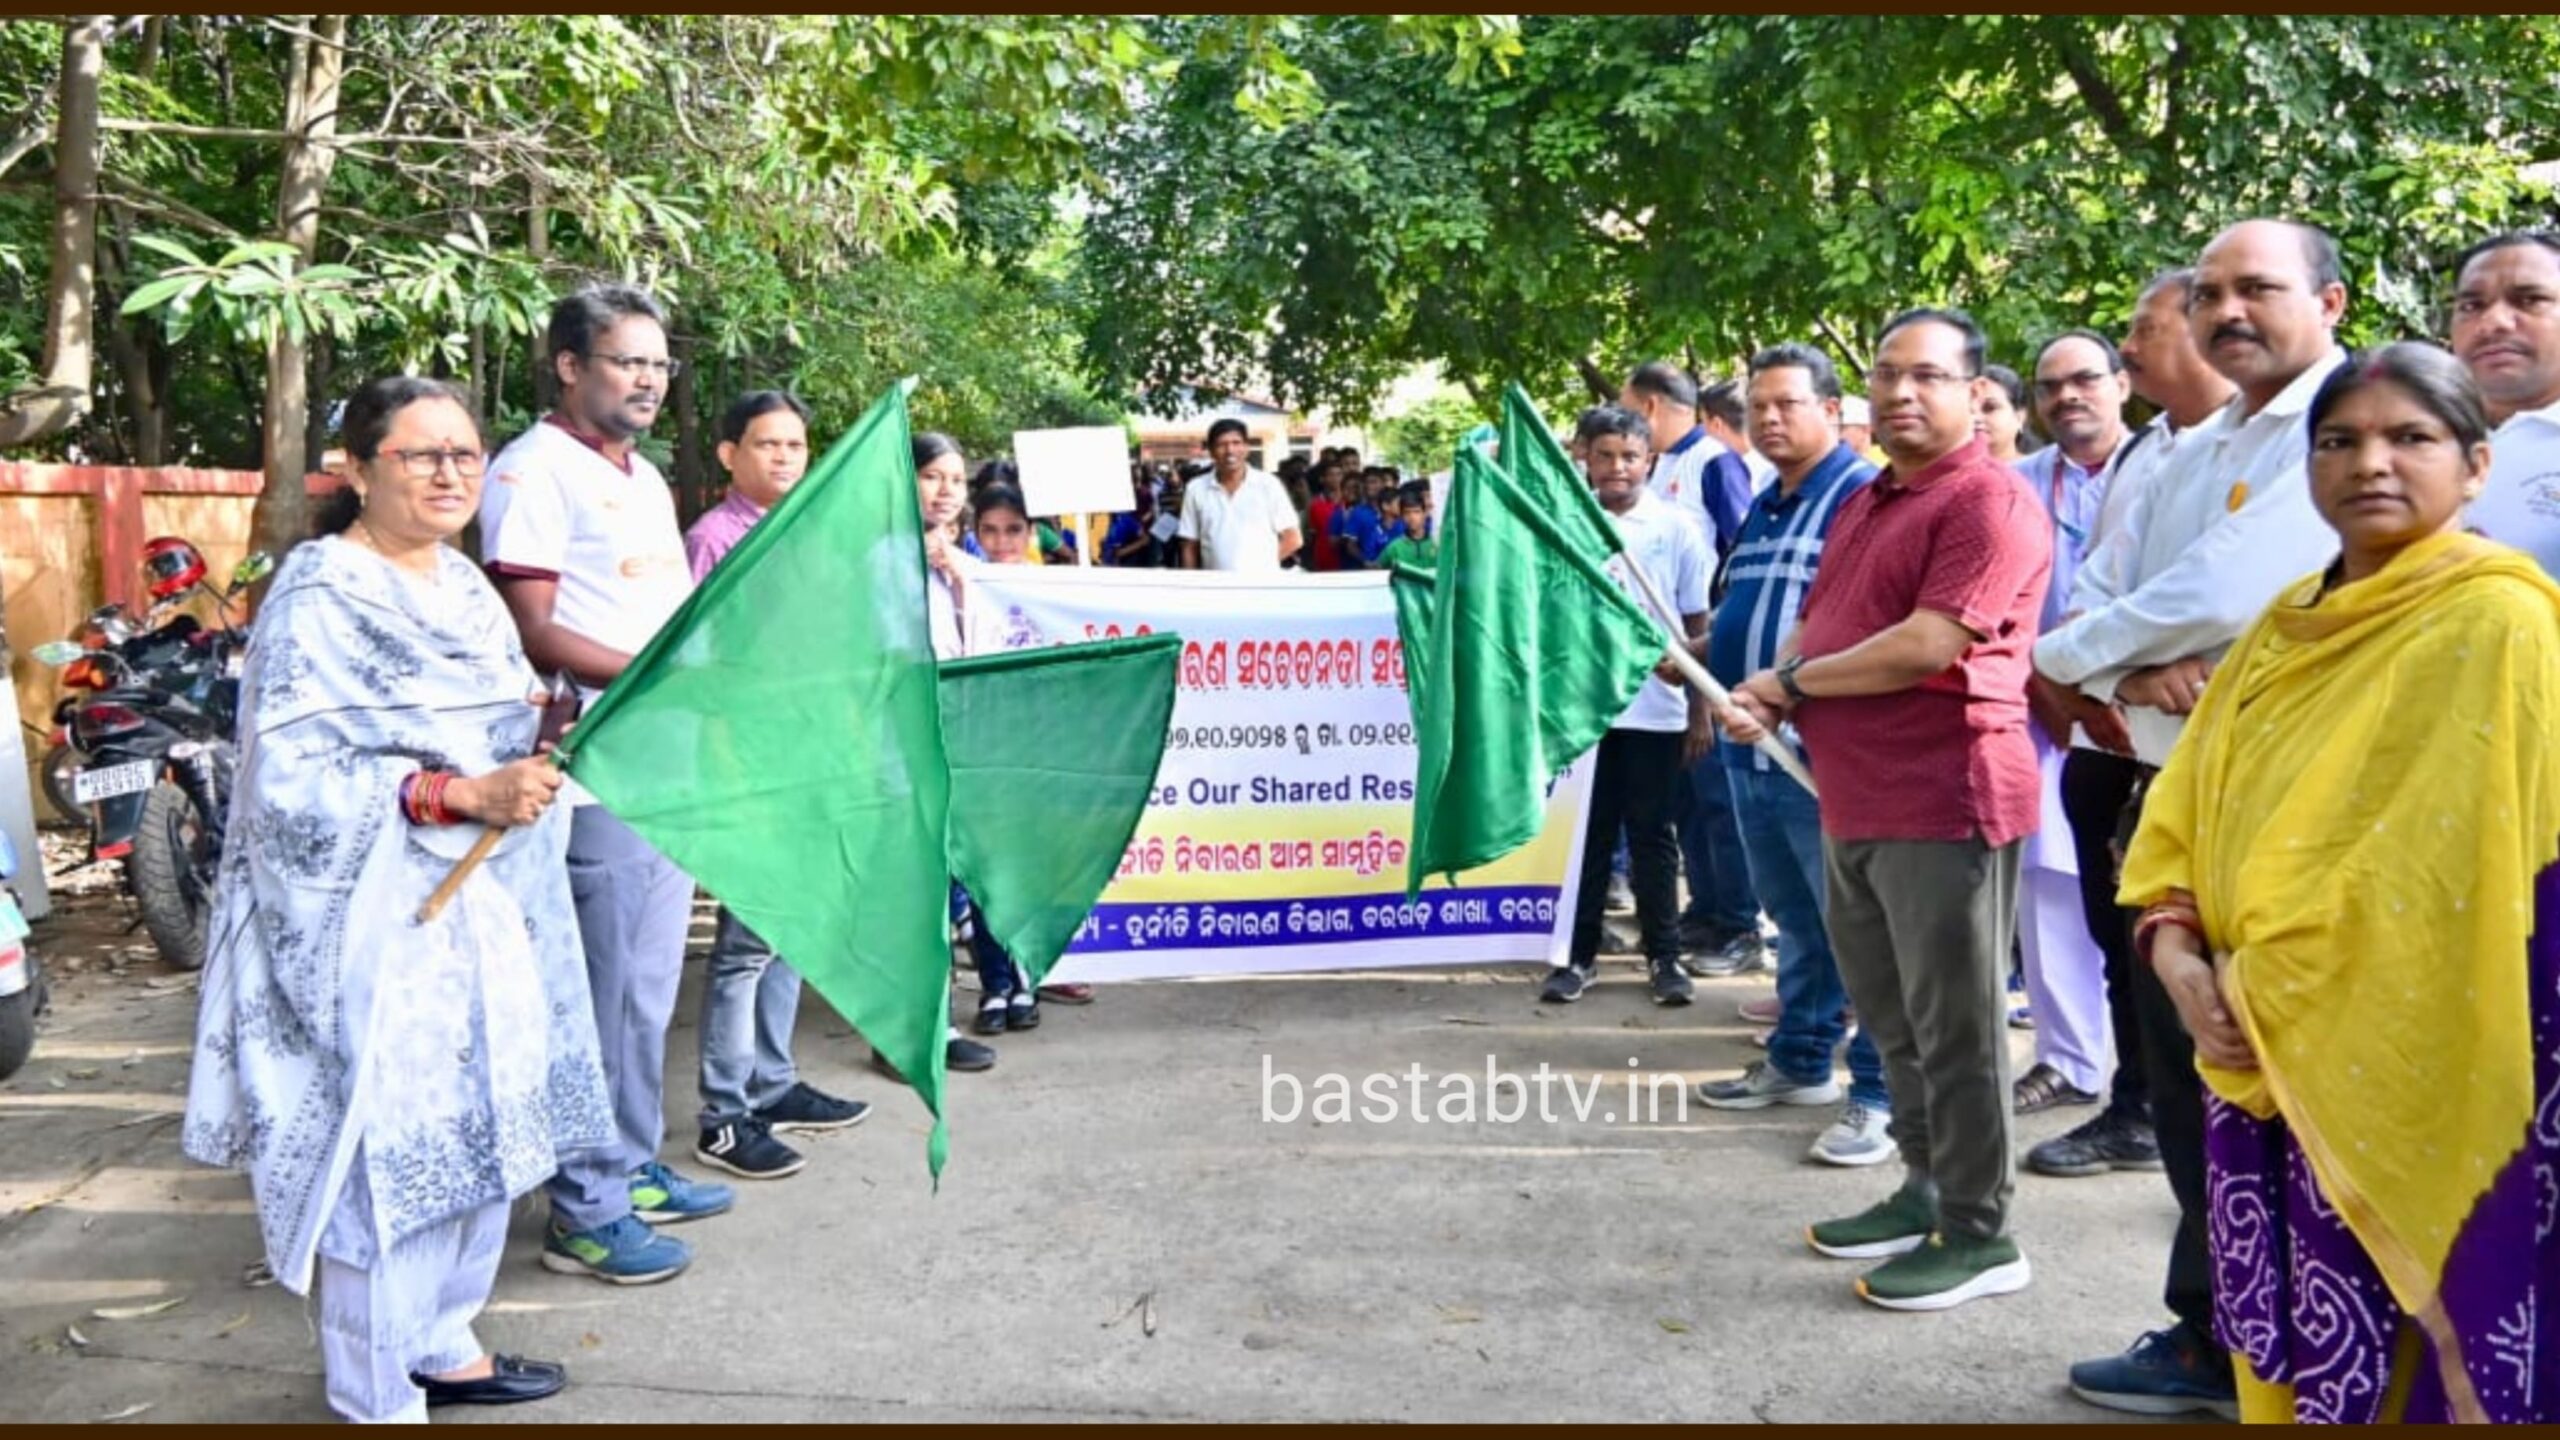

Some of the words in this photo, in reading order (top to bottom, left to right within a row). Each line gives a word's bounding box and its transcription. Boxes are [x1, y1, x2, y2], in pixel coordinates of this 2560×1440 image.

[1188, 777, 1241, 805] Our
[1250, 774, 1351, 804] Shared
[1199, 904, 1280, 938] ନିବାରଣ
